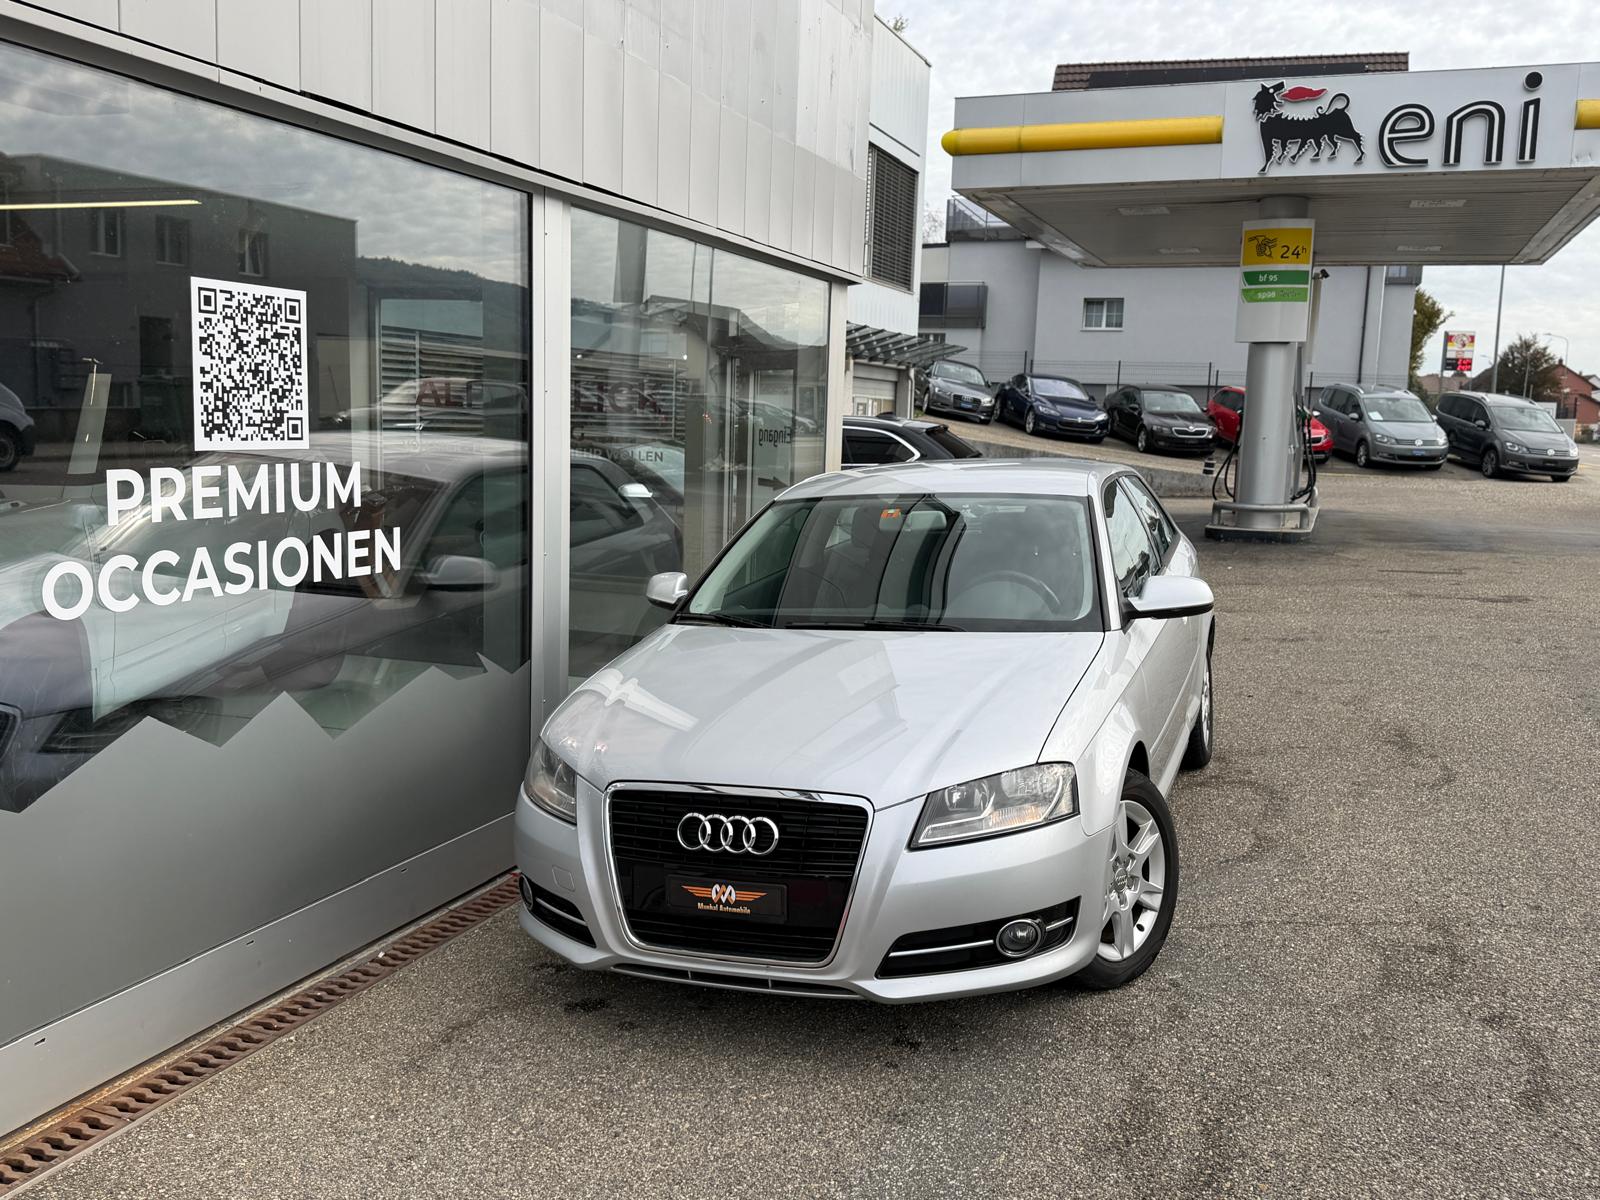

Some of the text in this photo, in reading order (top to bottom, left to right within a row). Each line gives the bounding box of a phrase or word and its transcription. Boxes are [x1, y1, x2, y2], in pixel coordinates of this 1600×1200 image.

[1378, 71, 1544, 168] eni
[106, 461, 363, 527] PREMIUM
[42, 526, 402, 621] OCCASIONEN
